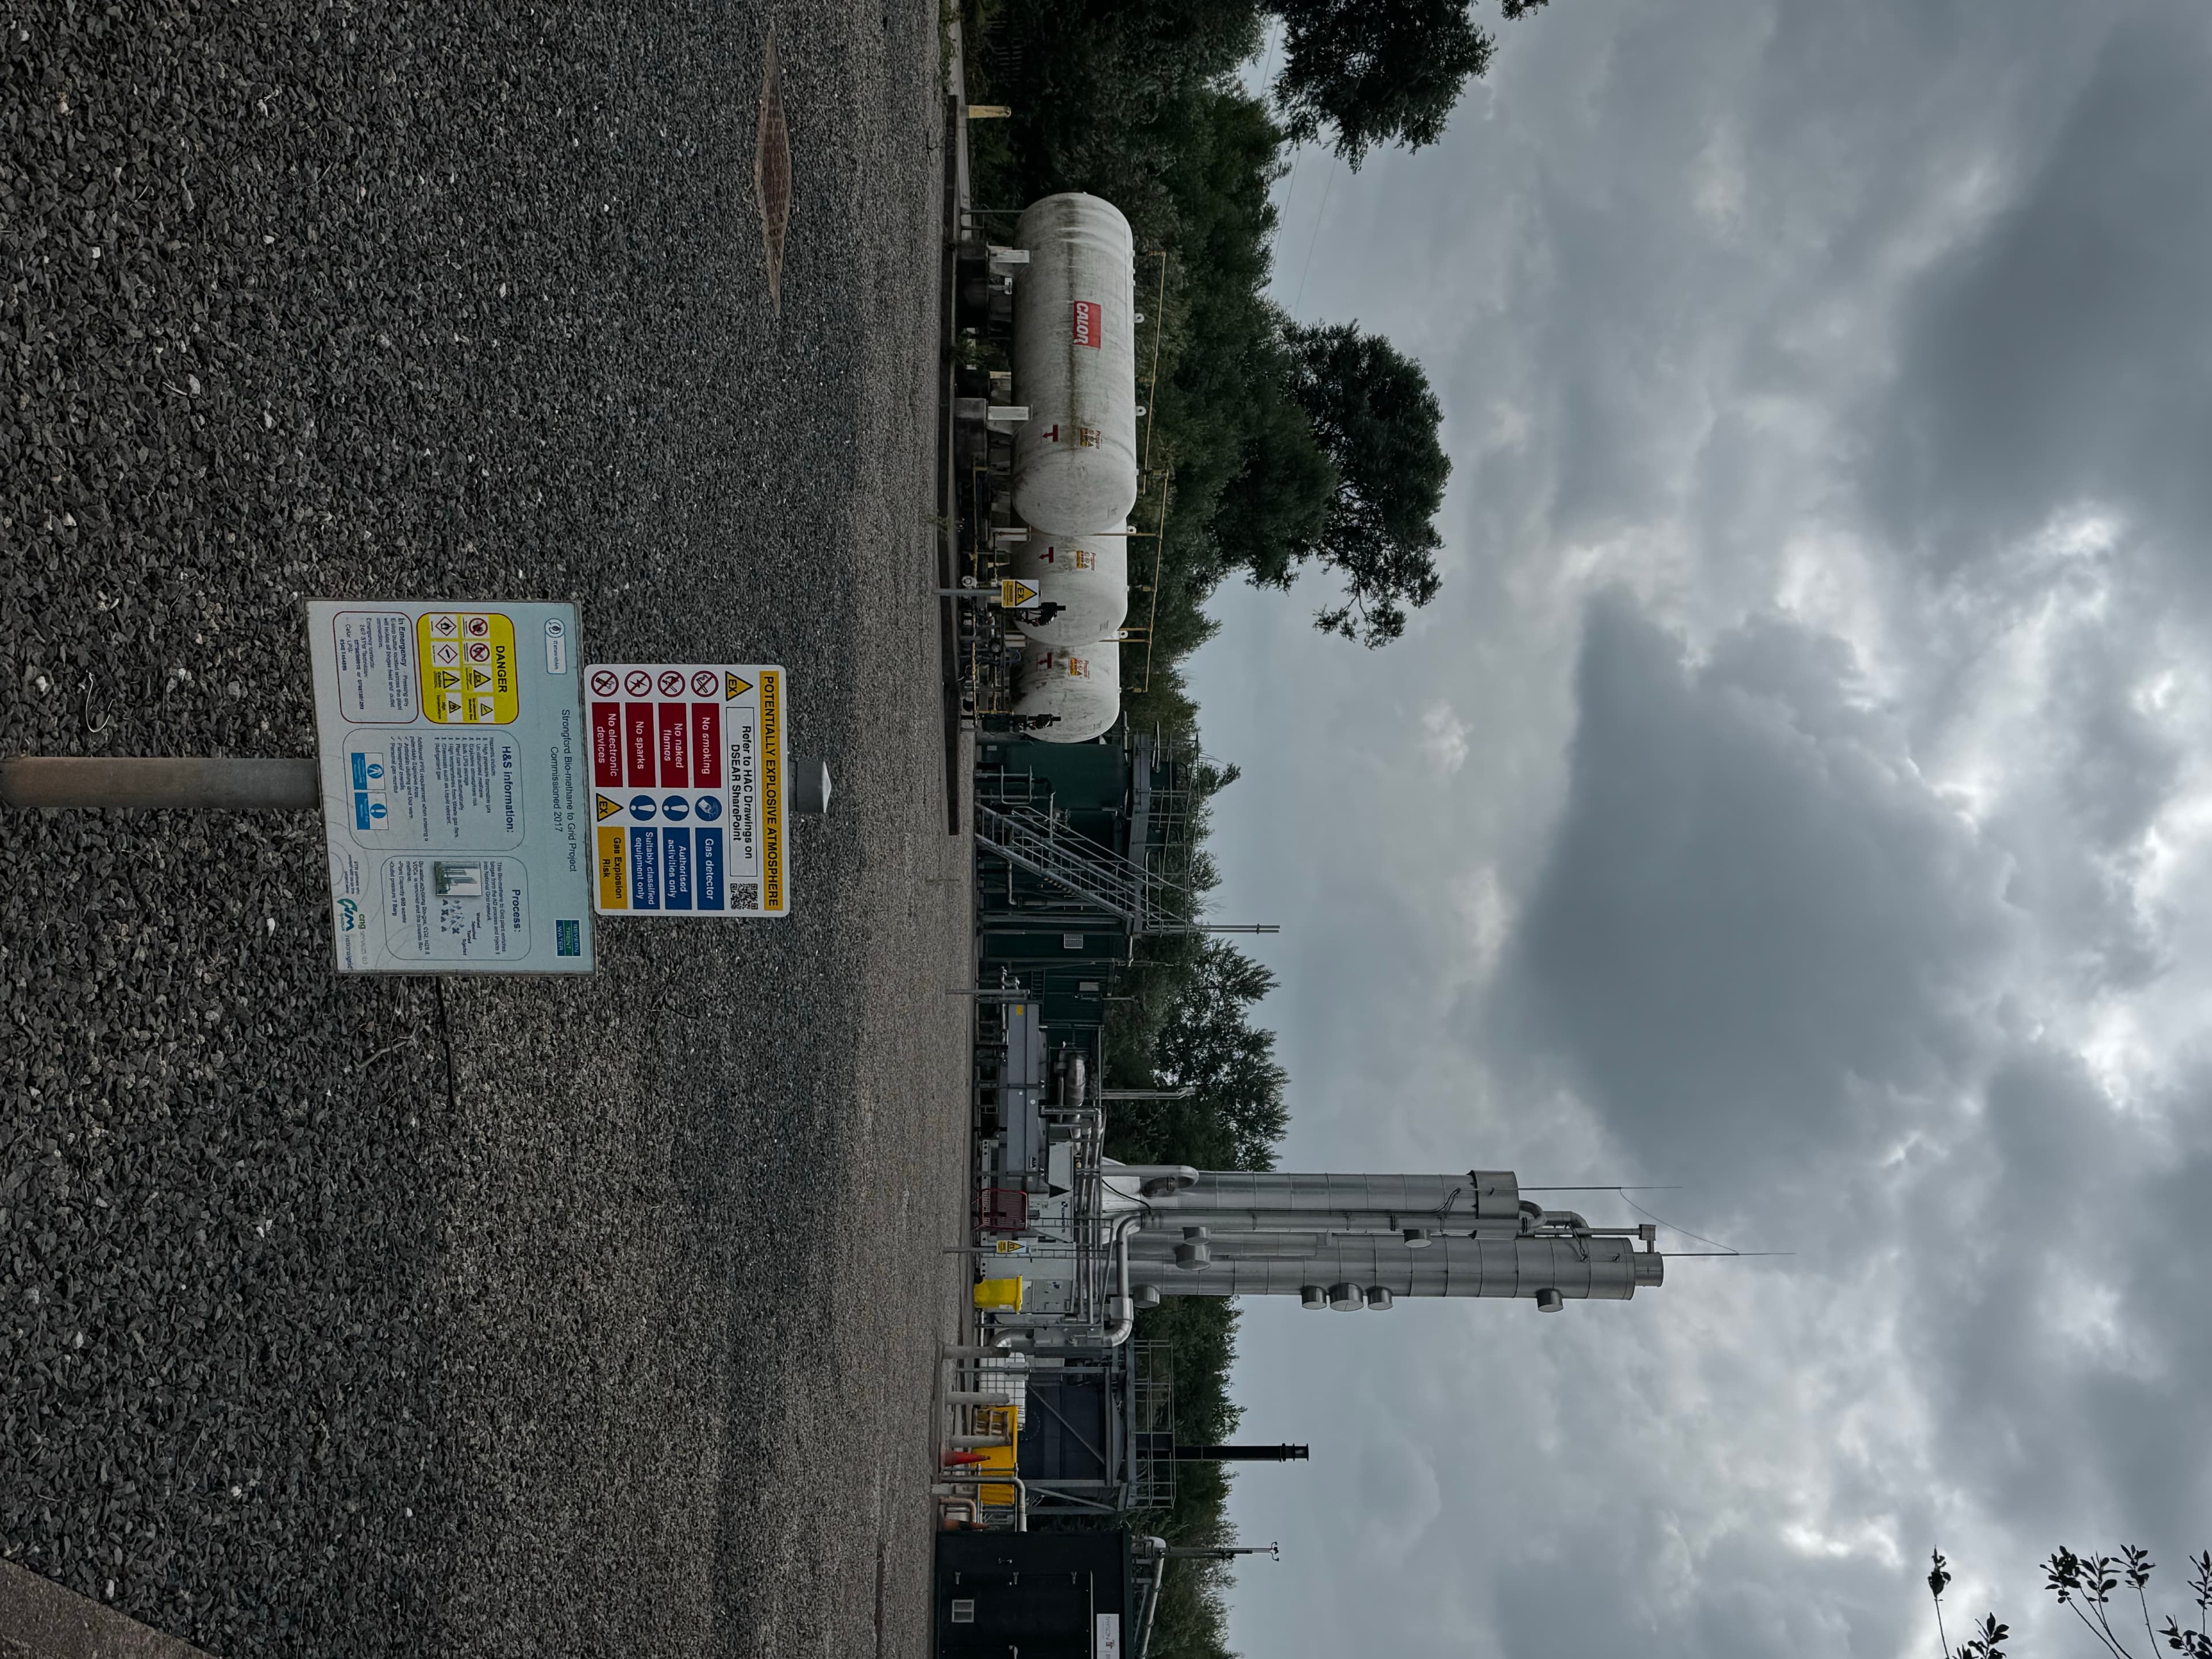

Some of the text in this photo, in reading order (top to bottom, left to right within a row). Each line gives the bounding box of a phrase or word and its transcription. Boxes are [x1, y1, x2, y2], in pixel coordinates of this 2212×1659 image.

[1073, 302, 1089, 344] CALOR
[1017, 588, 1024, 599] EX
[399, 627, 407, 666] Emergency
[495, 646, 507, 693] DANGER
[475, 675, 481, 683] EX
[728, 679, 737, 693] EX
[597, 726, 605, 764] devices
[608, 713, 618, 777] No electronic
[634, 721, 645, 770] No sparks
[663, 729, 672, 761] flames
[674, 723, 684, 768] No naked
[702, 717, 711, 774] No smoking
[502, 746, 515, 833] H&S information:
[550, 747, 563, 832] Commissioned 2017
[561, 709, 577, 872] Strongford Bio-methane to Grid Project
[599, 801, 608, 814] EX
[731, 744, 741, 841] DSEAR SharePoint
[743, 726, 753, 859] Refer to HAC Drawings on
[764, 676, 778, 906] POTENTIALLY EXPLOSIVE ATMOSPHERE
[602, 859, 610, 877] Risk
[613, 838, 623, 899] Gas Explosion
[634, 837, 645, 899] equipment only
[645, 832, 655, 904] Suitably classified
[667, 839, 677, 898] activities only
[679, 845, 687, 892] Authorised
[704, 838, 714, 900] Gas detector
[512, 889, 521, 933] Process:
